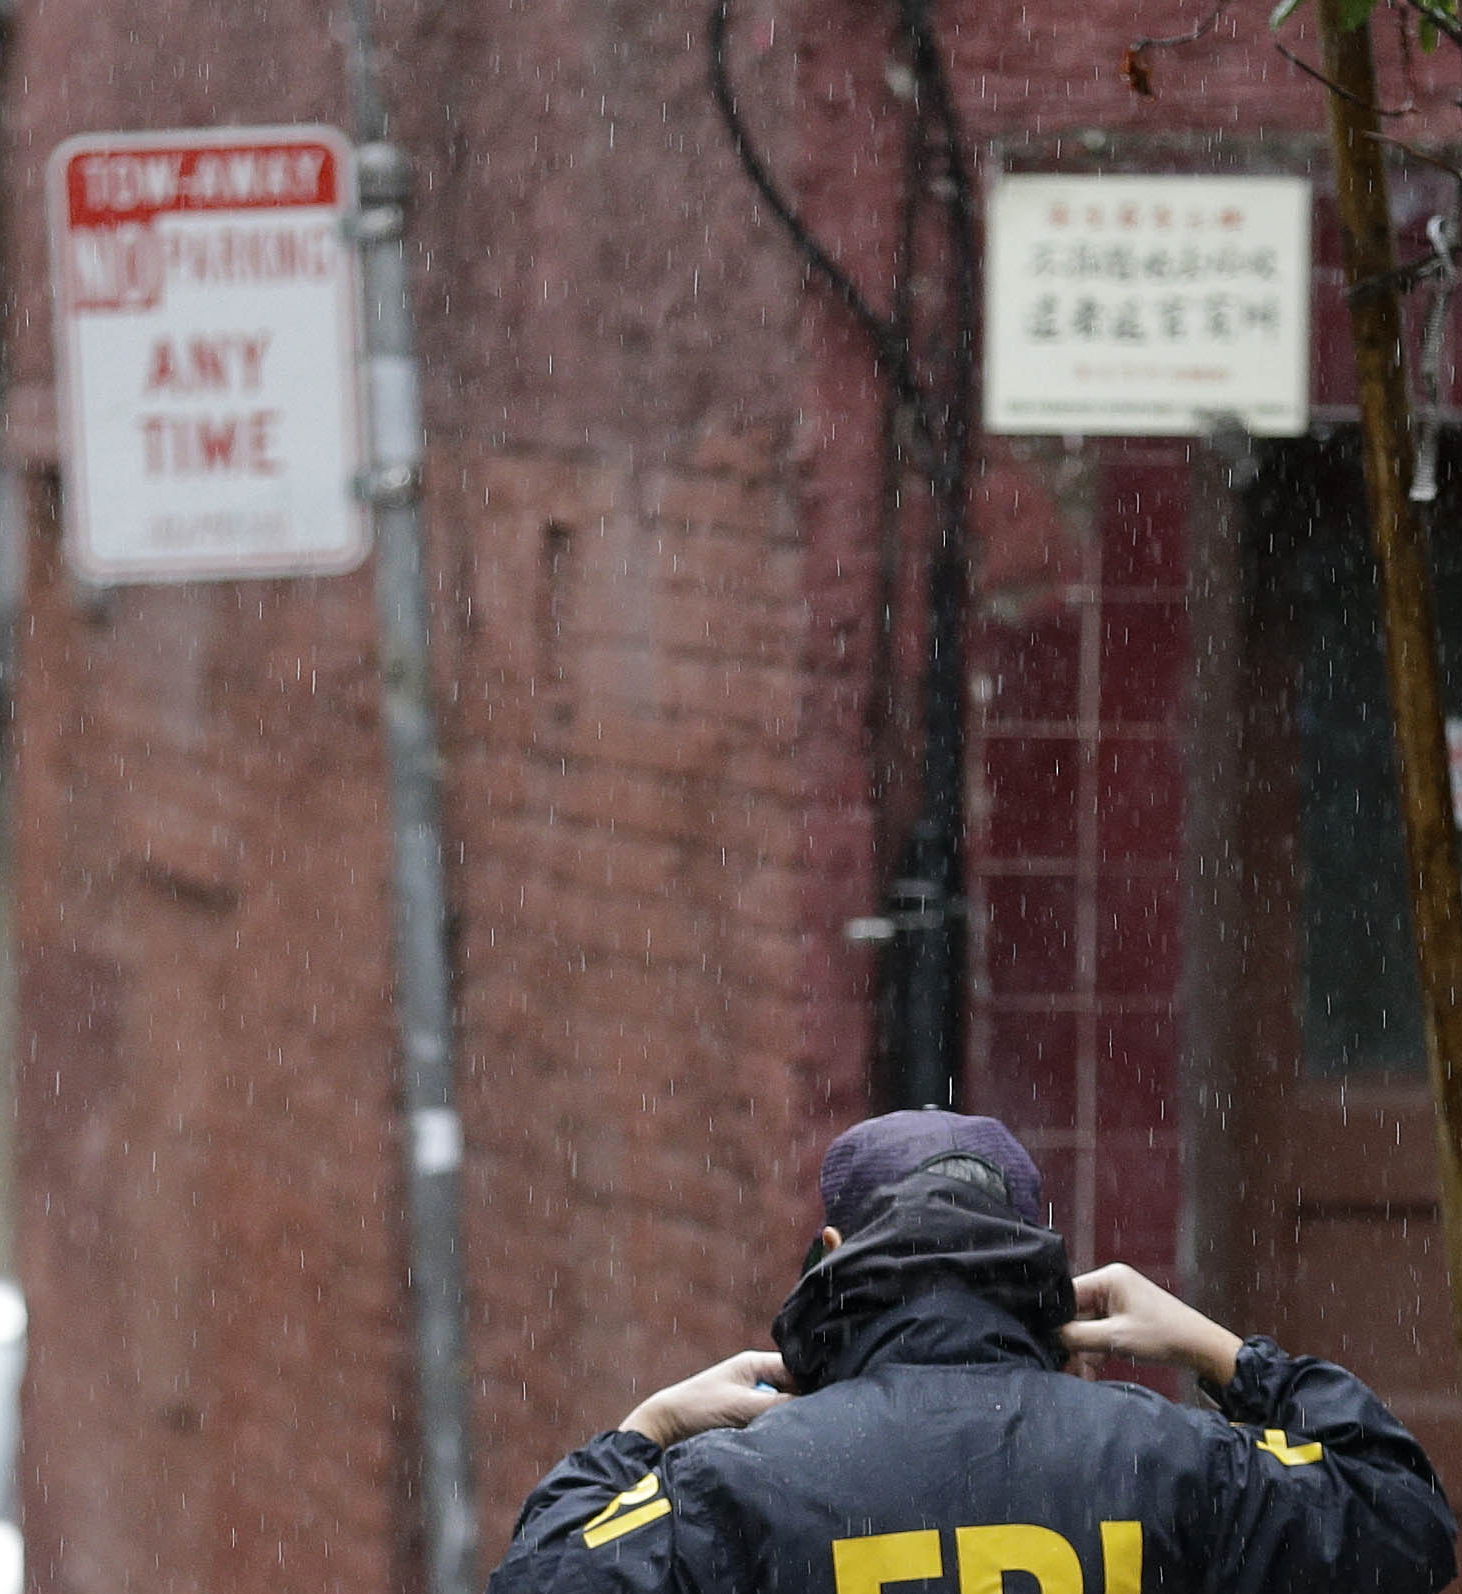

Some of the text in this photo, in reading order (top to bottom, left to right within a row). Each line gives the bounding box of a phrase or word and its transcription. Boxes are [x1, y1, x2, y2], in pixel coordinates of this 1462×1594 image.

[83, 146, 328, 213] TOW-AWAY
[146, 329, 272, 394] ANY
[141, 409, 285, 479] TIME
